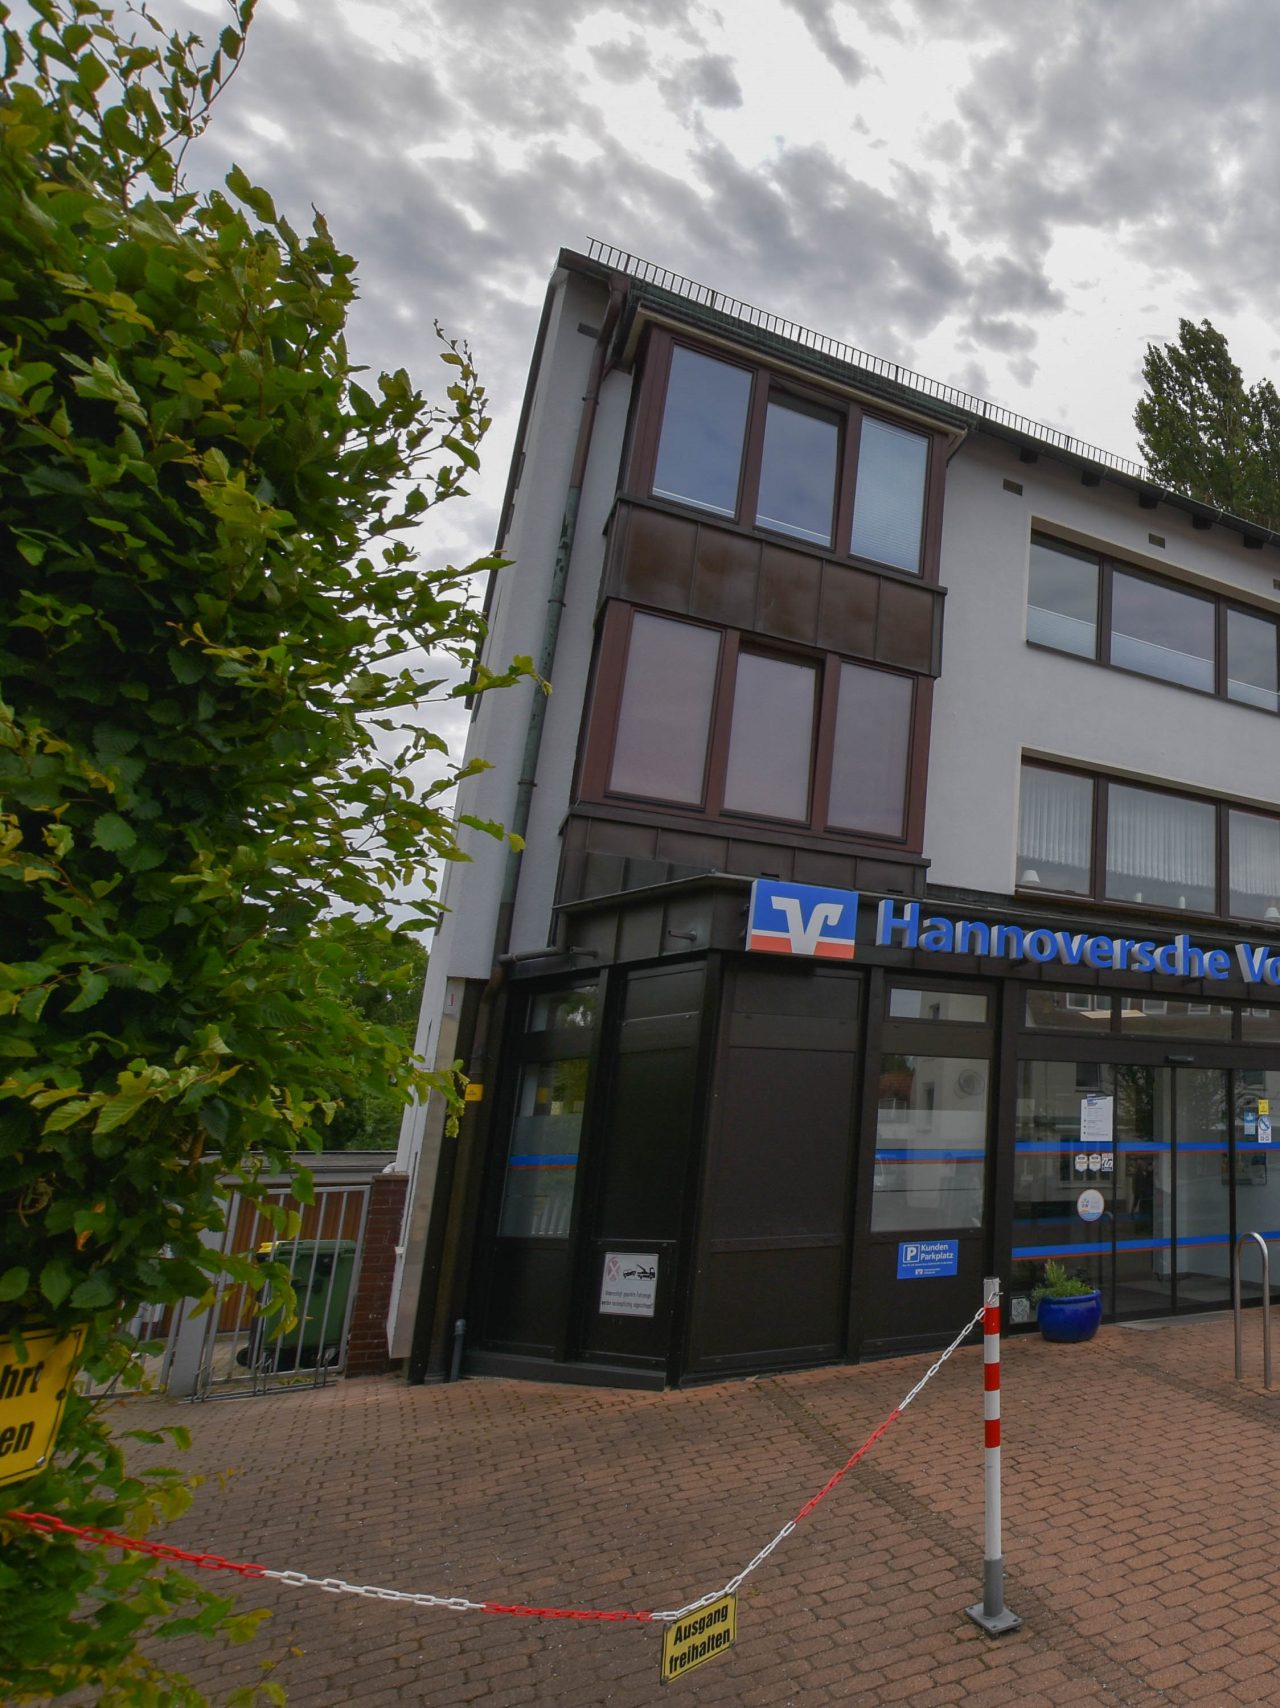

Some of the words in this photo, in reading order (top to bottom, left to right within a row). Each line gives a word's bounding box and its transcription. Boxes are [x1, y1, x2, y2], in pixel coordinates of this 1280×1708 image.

[875, 899, 1231, 980] Hannoversche
[906, 1246, 917, 1261] P
[920, 1243, 949, 1252] Kunden
[920, 1252, 954, 1262] Parkplatz
[673, 1604, 729, 1646] Ausgang
[668, 1628, 731, 1675] freihalten
